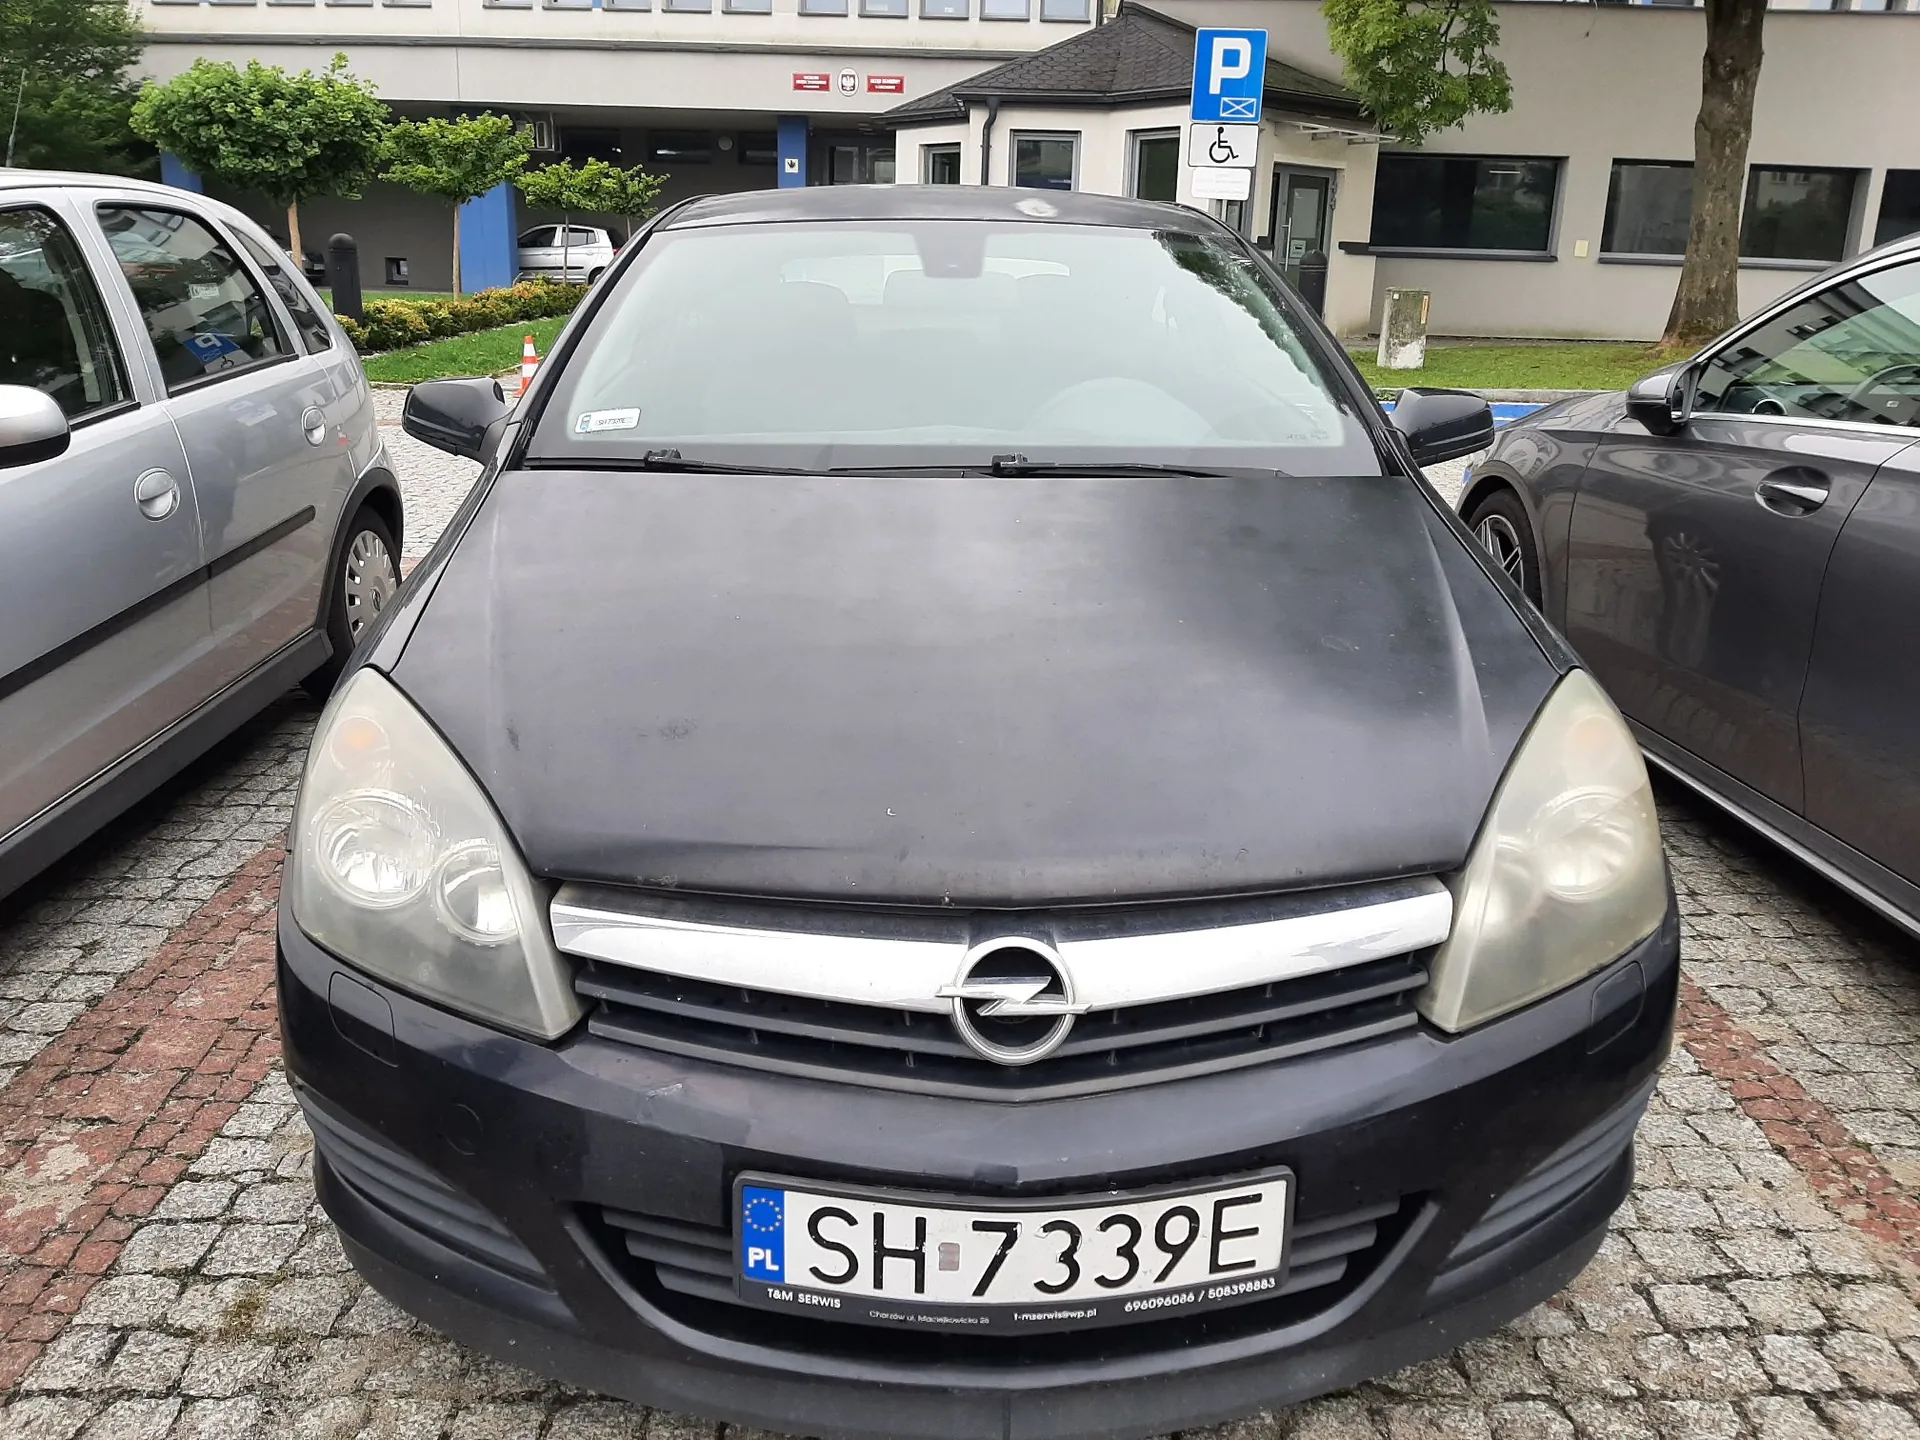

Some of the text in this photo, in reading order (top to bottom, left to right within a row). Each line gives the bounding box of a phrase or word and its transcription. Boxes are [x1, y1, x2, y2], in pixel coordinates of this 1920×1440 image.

[1209, 37, 1251, 94] P
[748, 1247, 779, 1271] PL
[808, 1193, 1262, 1296] SH 7339E
[767, 1288, 841, 1309] T&M SERWIS
[1124, 1292, 1195, 1312] 696096086
[1208, 1277, 1275, 1299] 508398883
